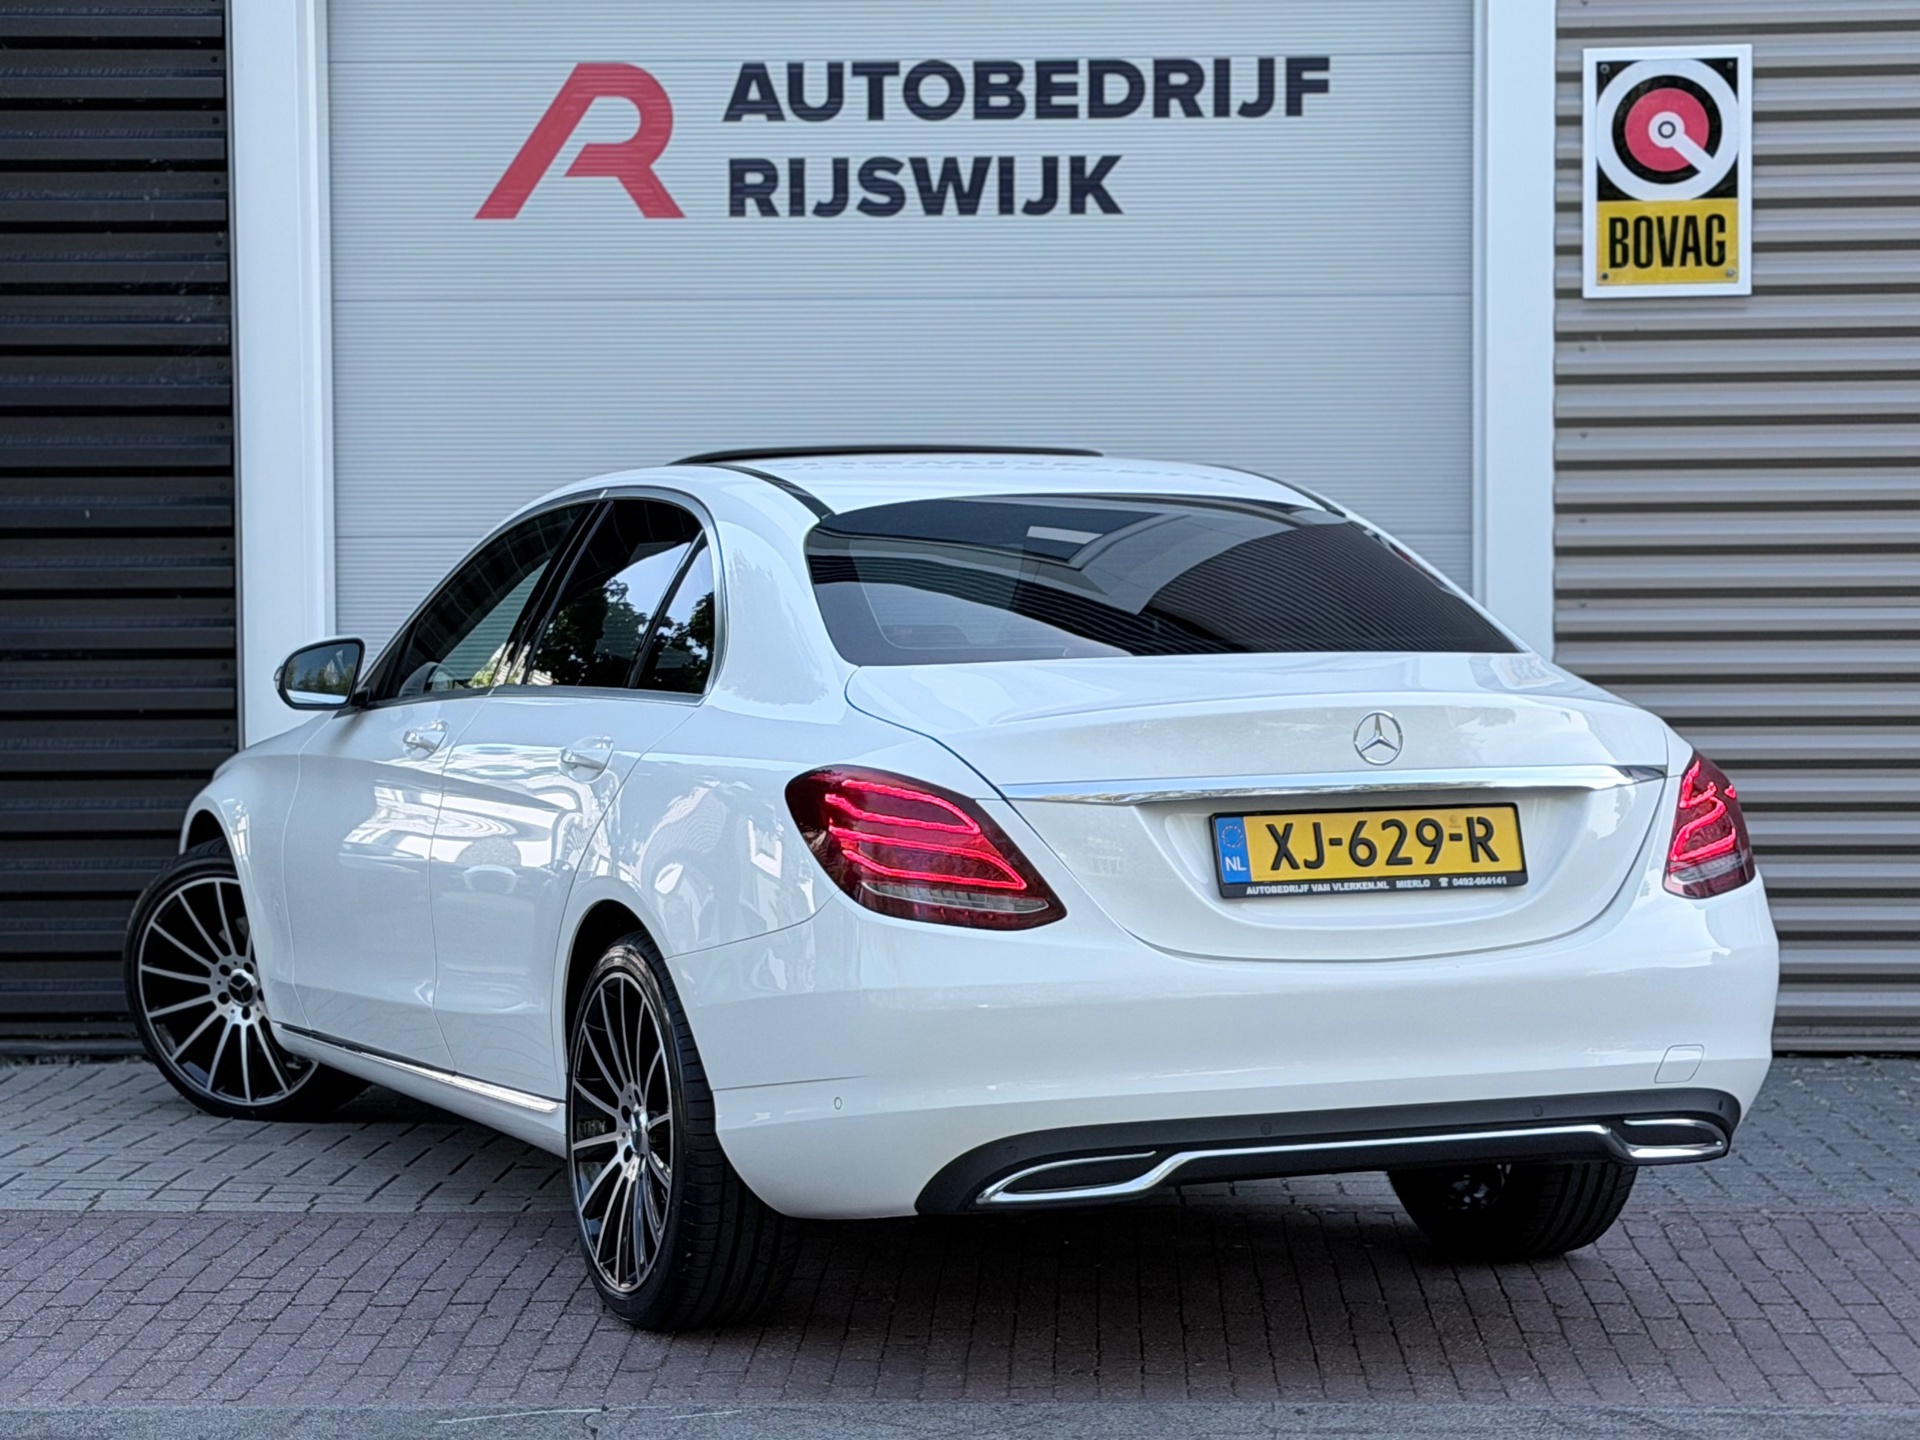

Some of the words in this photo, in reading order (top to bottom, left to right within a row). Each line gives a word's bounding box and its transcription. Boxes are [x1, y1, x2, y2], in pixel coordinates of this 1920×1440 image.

[722, 56, 1331, 123] AUTOBEDRIJF
[728, 154, 1124, 218] RIJSWIJK
[1608, 213, 1727, 269] BOVAG
[1224, 855, 1248, 872] NL
[1264, 816, 1500, 872] XJ-629-R
[1245, 883, 1310, 896] AUTOBEDRIJF
[1310, 882, 1332, 893] VAN
[1331, 880, 1391, 892] VLERKEN.NL
[1395, 878, 1432, 890] MIERLO
